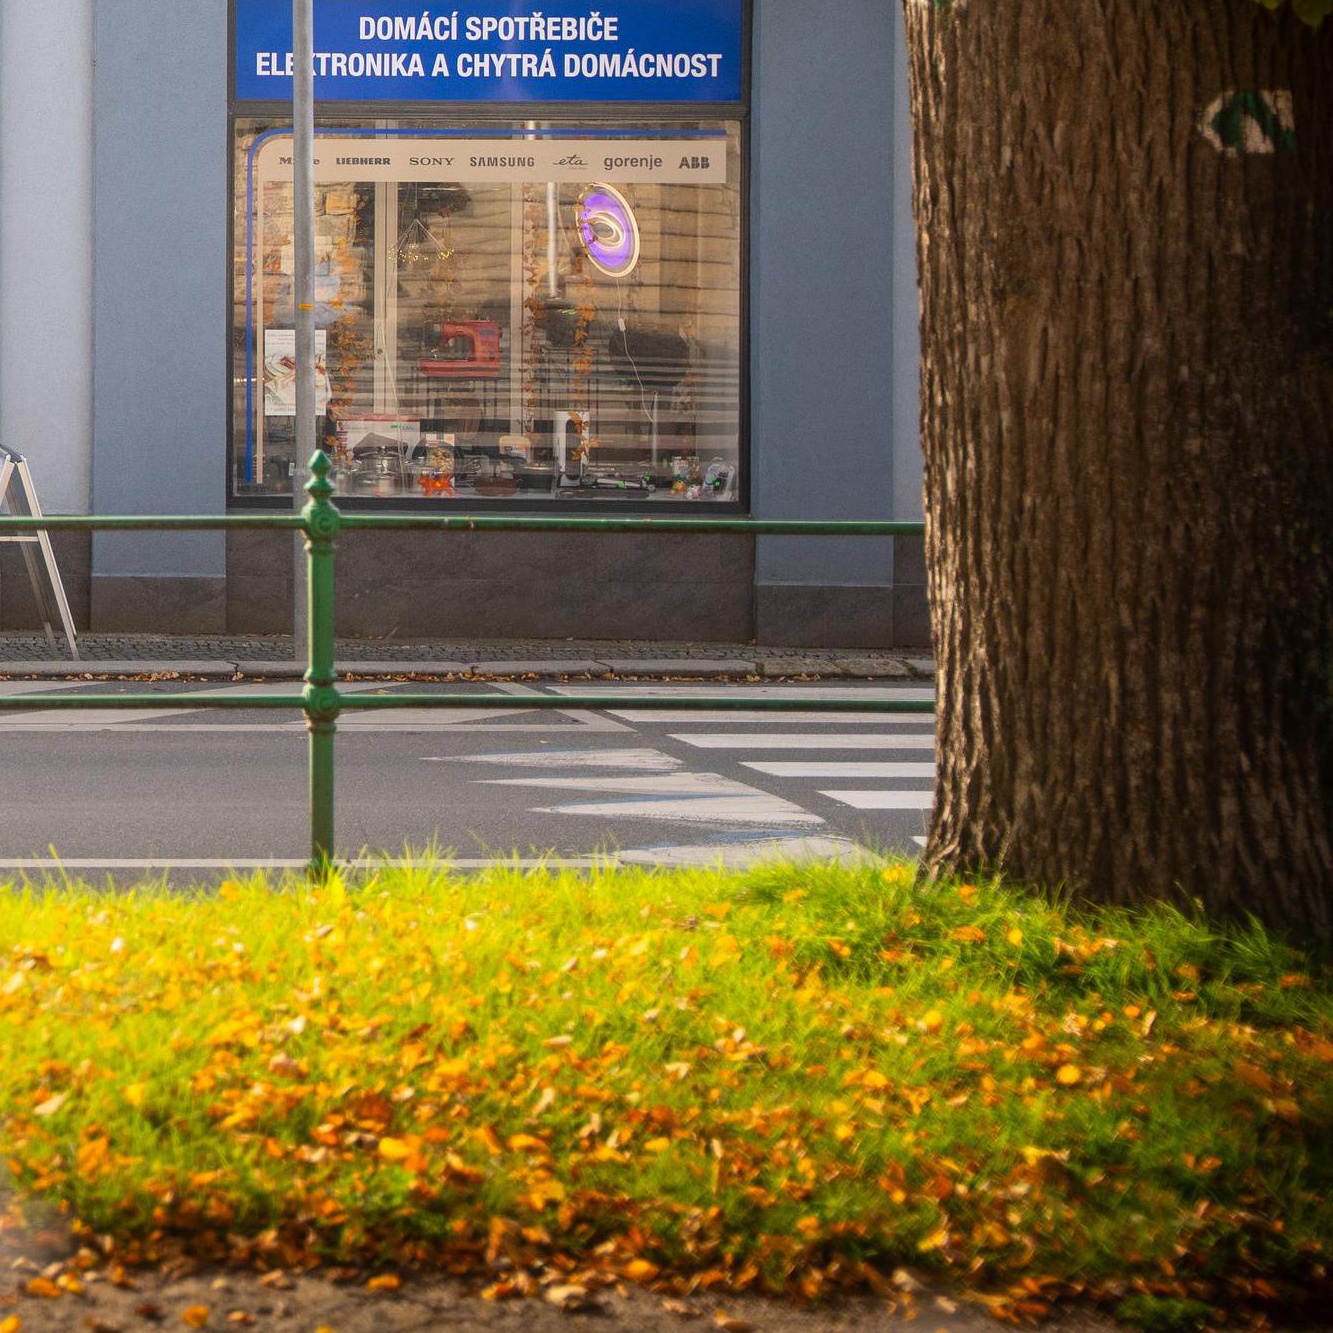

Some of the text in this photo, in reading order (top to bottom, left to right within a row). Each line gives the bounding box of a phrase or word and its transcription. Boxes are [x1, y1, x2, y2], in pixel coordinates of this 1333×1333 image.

[359, 11, 619, 41] DOMÁCÍ SPOTŘEBIČE
[256, 48, 722, 78] ELETRONIKA A CHYTRÁ DOMÁCNOST
[336, 157, 391, 165] LIEBHERR
[409, 157, 455, 166] SONY
[469, 156, 536, 167] SAMSUNG
[553, 154, 588, 166] eta
[604, 155, 662, 170] gorenje
[679, 156, 710, 169] ABB
